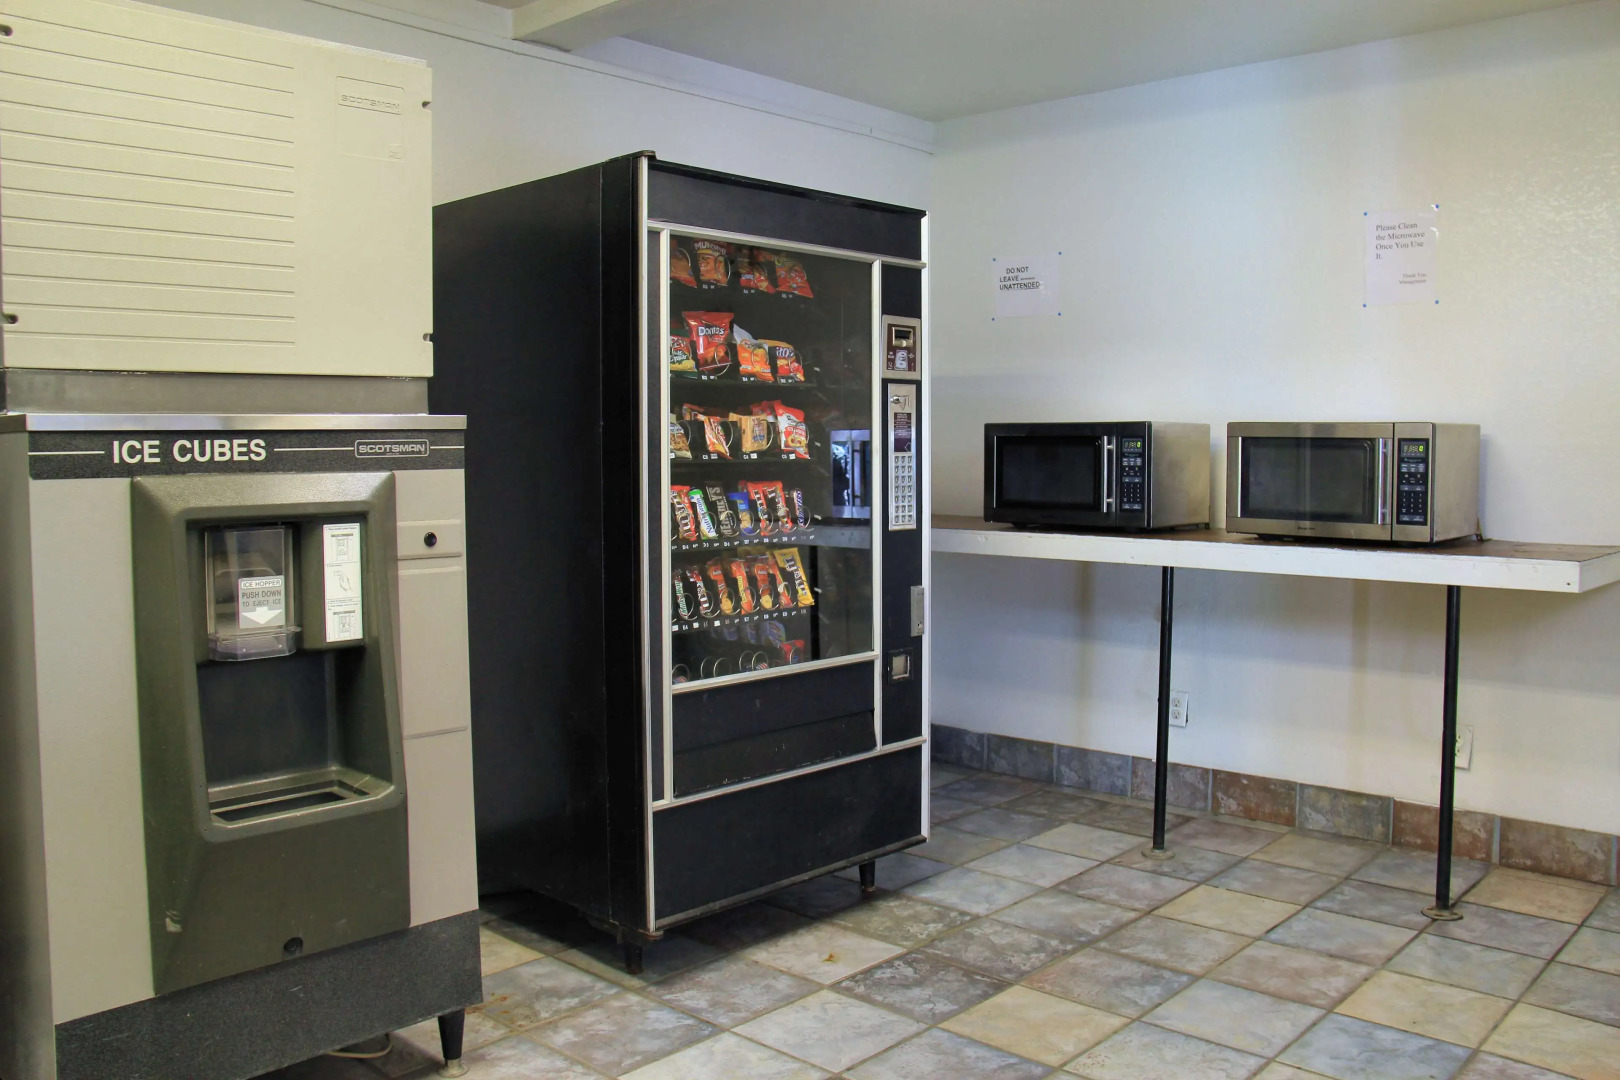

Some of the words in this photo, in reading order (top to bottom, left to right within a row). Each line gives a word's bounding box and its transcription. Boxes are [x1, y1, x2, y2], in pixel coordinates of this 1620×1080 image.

[340, 94, 400, 110] SCOTSMAN
[1000, 281, 1040, 290] UNATTENDED
[698, 326, 725, 336] Doritos
[113, 440, 161, 464] ICE
[172, 439, 266, 462] CUBES
[359, 444, 425, 453] SCOTSMAN
